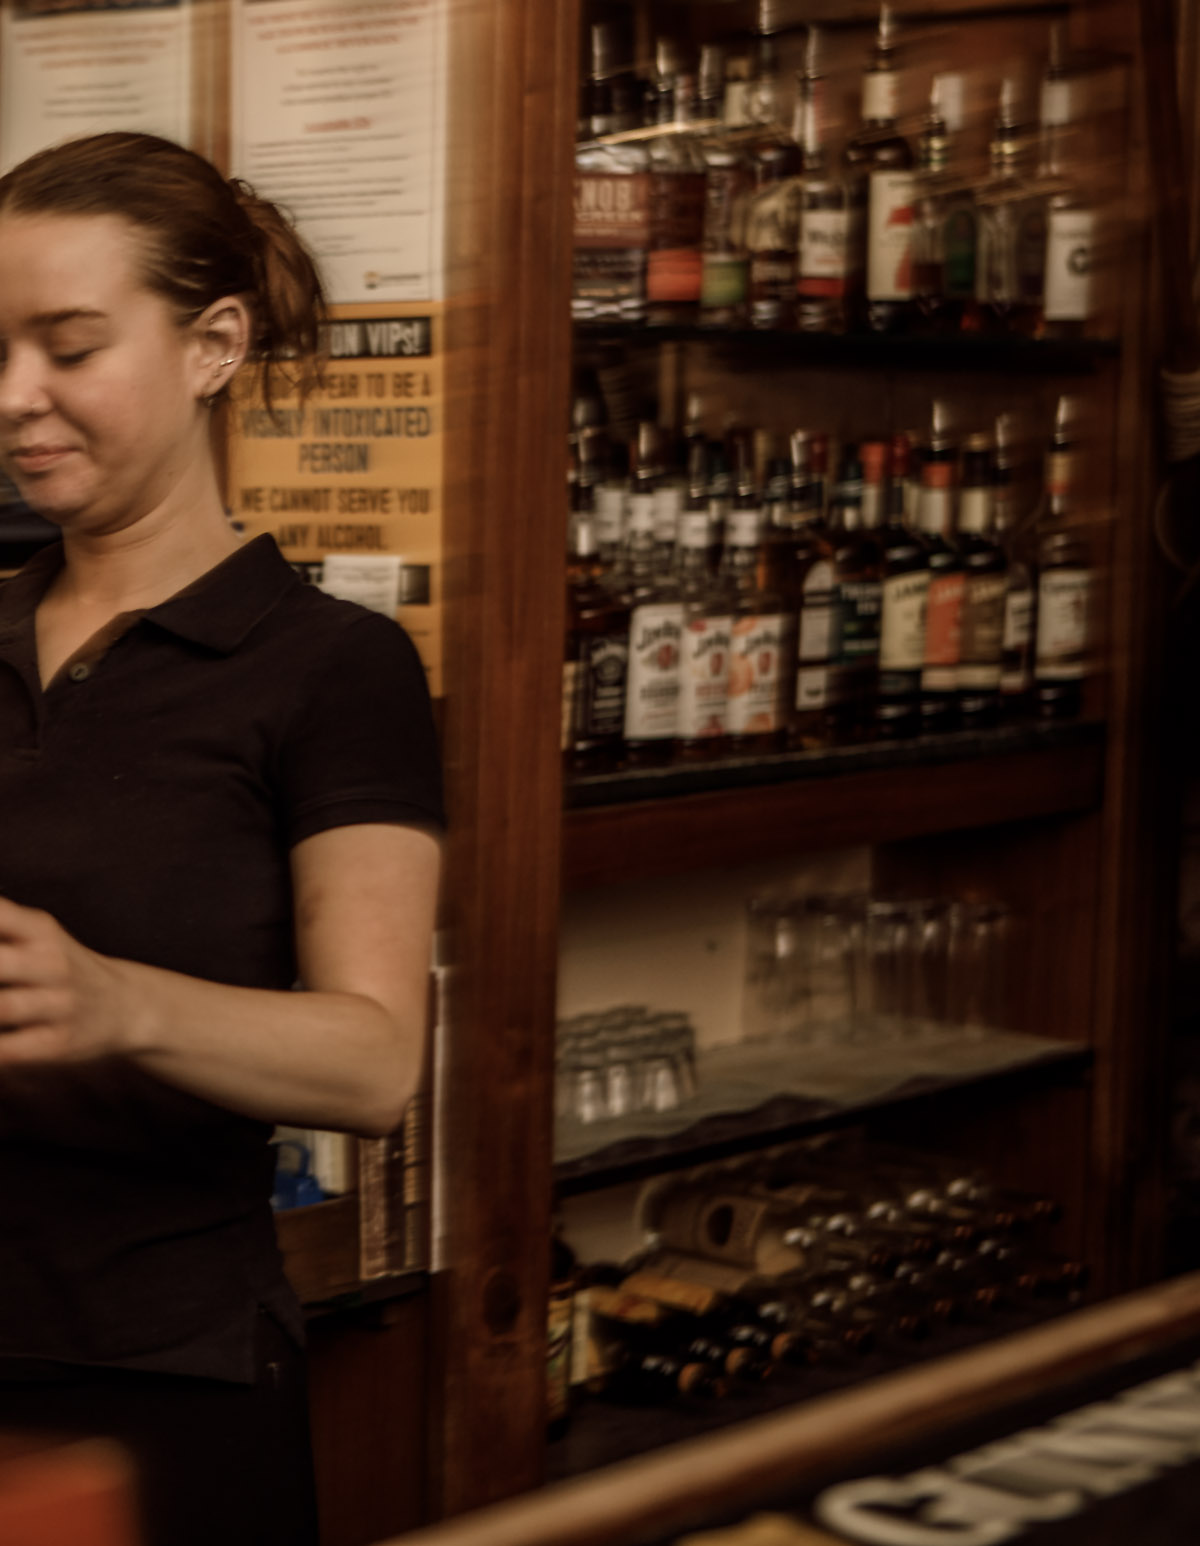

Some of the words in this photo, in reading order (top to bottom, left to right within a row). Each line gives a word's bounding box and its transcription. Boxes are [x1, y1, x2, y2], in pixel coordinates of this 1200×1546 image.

[365, 372, 386, 399] TO
[392, 371, 418, 399] BE
[421, 371, 432, 398] A
[314, 406, 431, 438] INTOXICATED
[299, 442, 370, 474] PERSON
[240, 486, 265, 514] WE
[269, 486, 331, 514] CANNOT
[338, 486, 392, 514] SERVE
[397, 486, 431, 514] YOU
[277, 523, 310, 548] ANY
